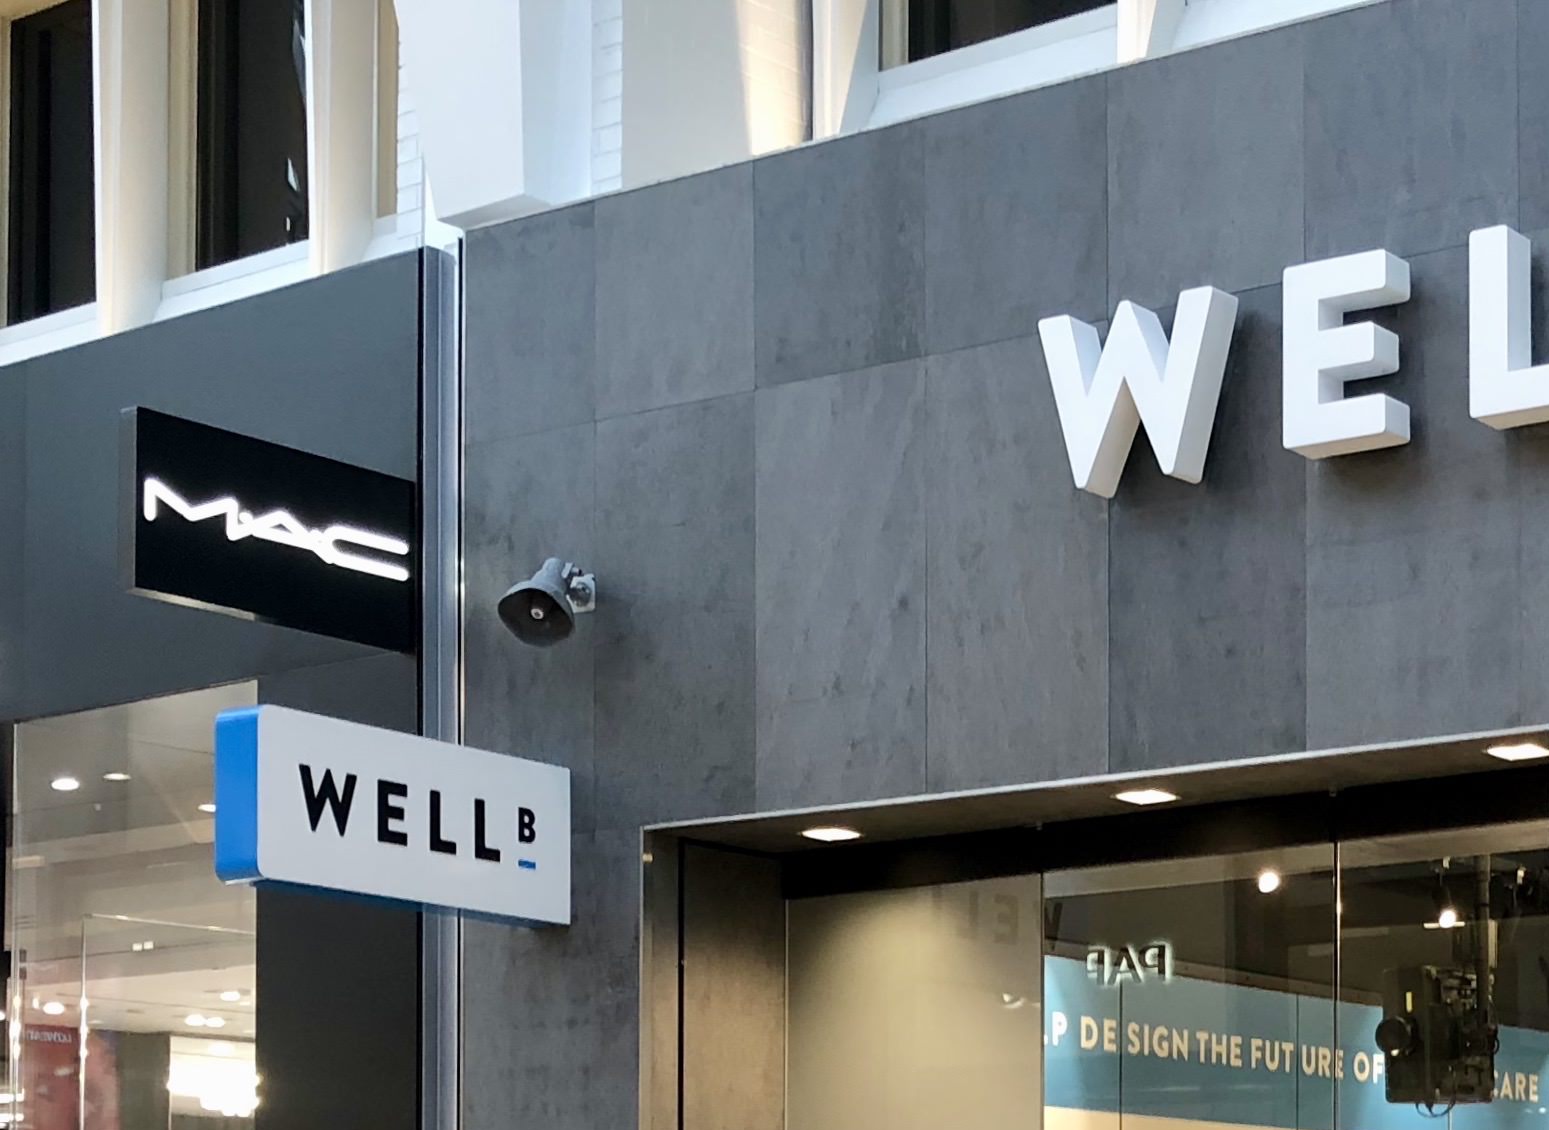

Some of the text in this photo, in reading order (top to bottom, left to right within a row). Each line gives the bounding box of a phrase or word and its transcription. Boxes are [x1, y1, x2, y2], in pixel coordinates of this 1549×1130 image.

[298, 763, 502, 863] WELL
[1080, 1015, 1189, 1062] DESIGN
[1196, 1030, 1242, 1067] THE
[1250, 1037, 1344, 1080] FUTURE
[1353, 1051, 1386, 1085] OF
